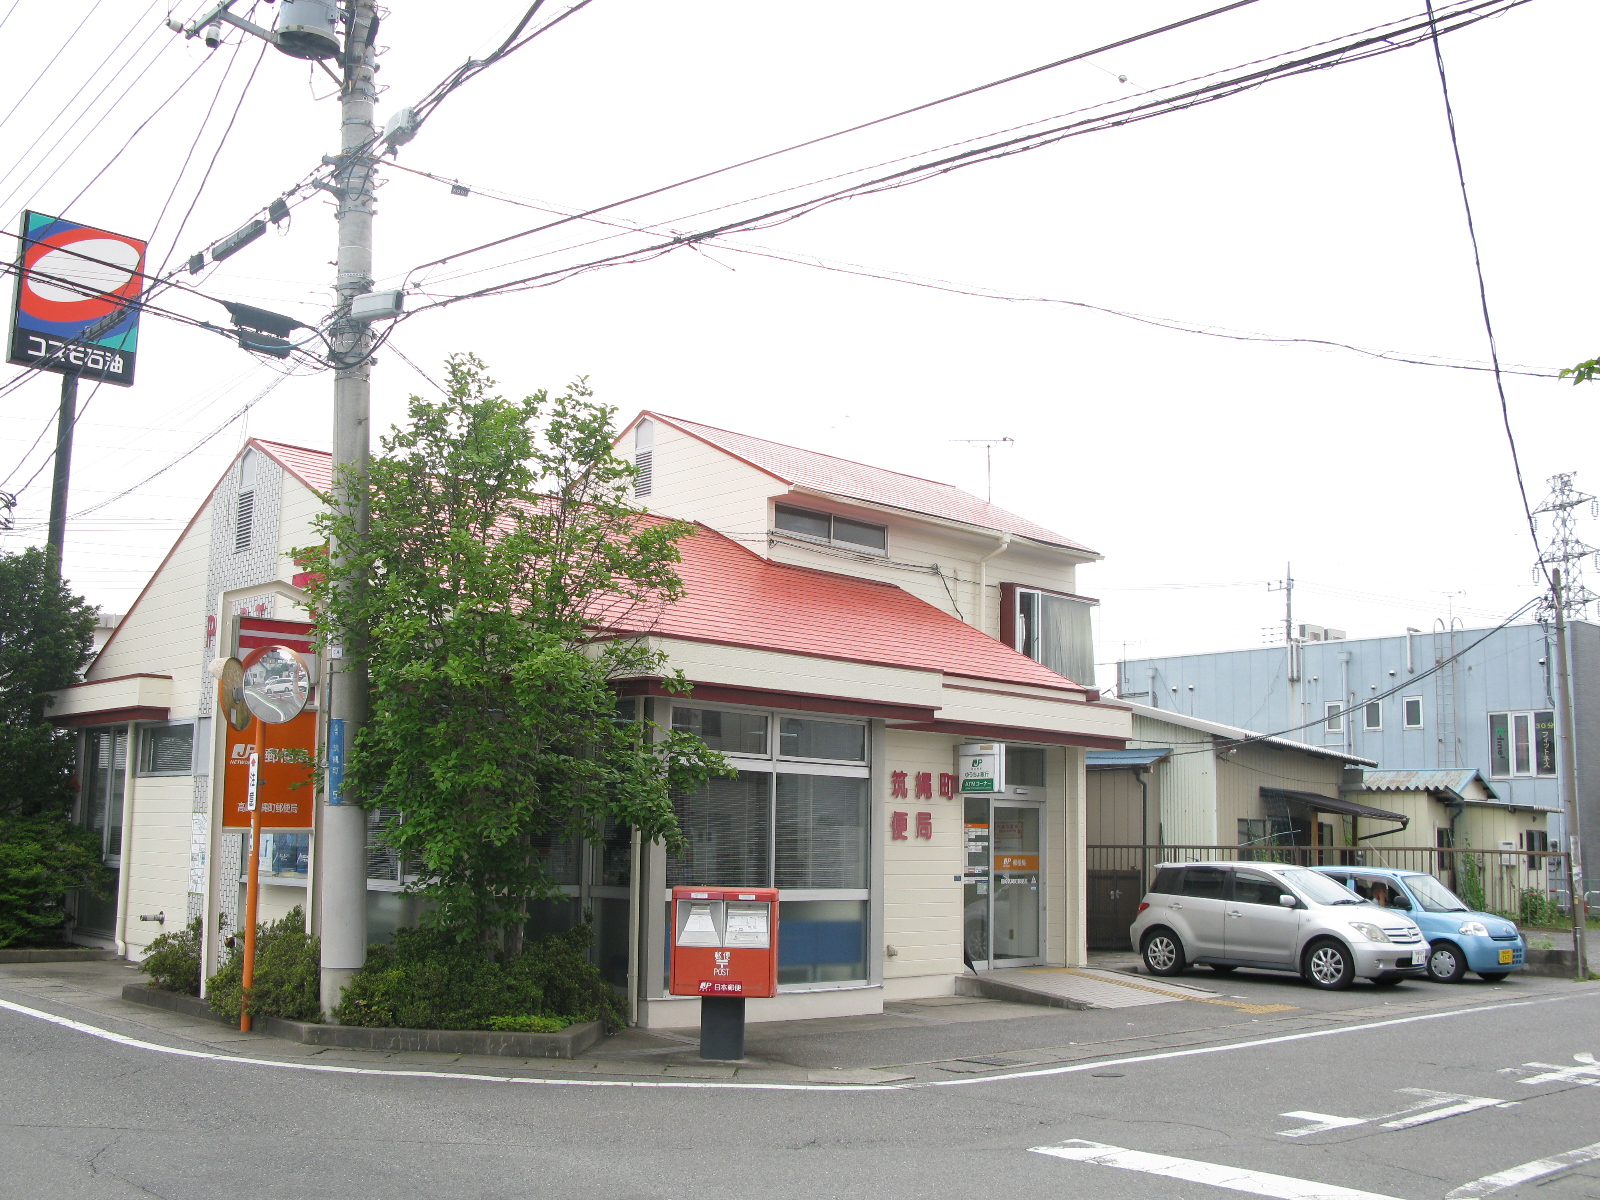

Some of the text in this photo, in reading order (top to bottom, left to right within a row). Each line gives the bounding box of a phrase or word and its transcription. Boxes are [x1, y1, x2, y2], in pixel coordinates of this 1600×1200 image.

[27, 335, 124, 374] コスモ石油
[1542, 731, 1551, 768] フィットネス
[891, 770, 956, 801] 筑縄町
[237, 801, 298, 814] 高縄町郵便局
[891, 810, 933, 841] 便局
[714, 951, 731, 961] 郵便
[713, 968, 730, 976] POST
[714, 983, 742, 992] 日本郵便
